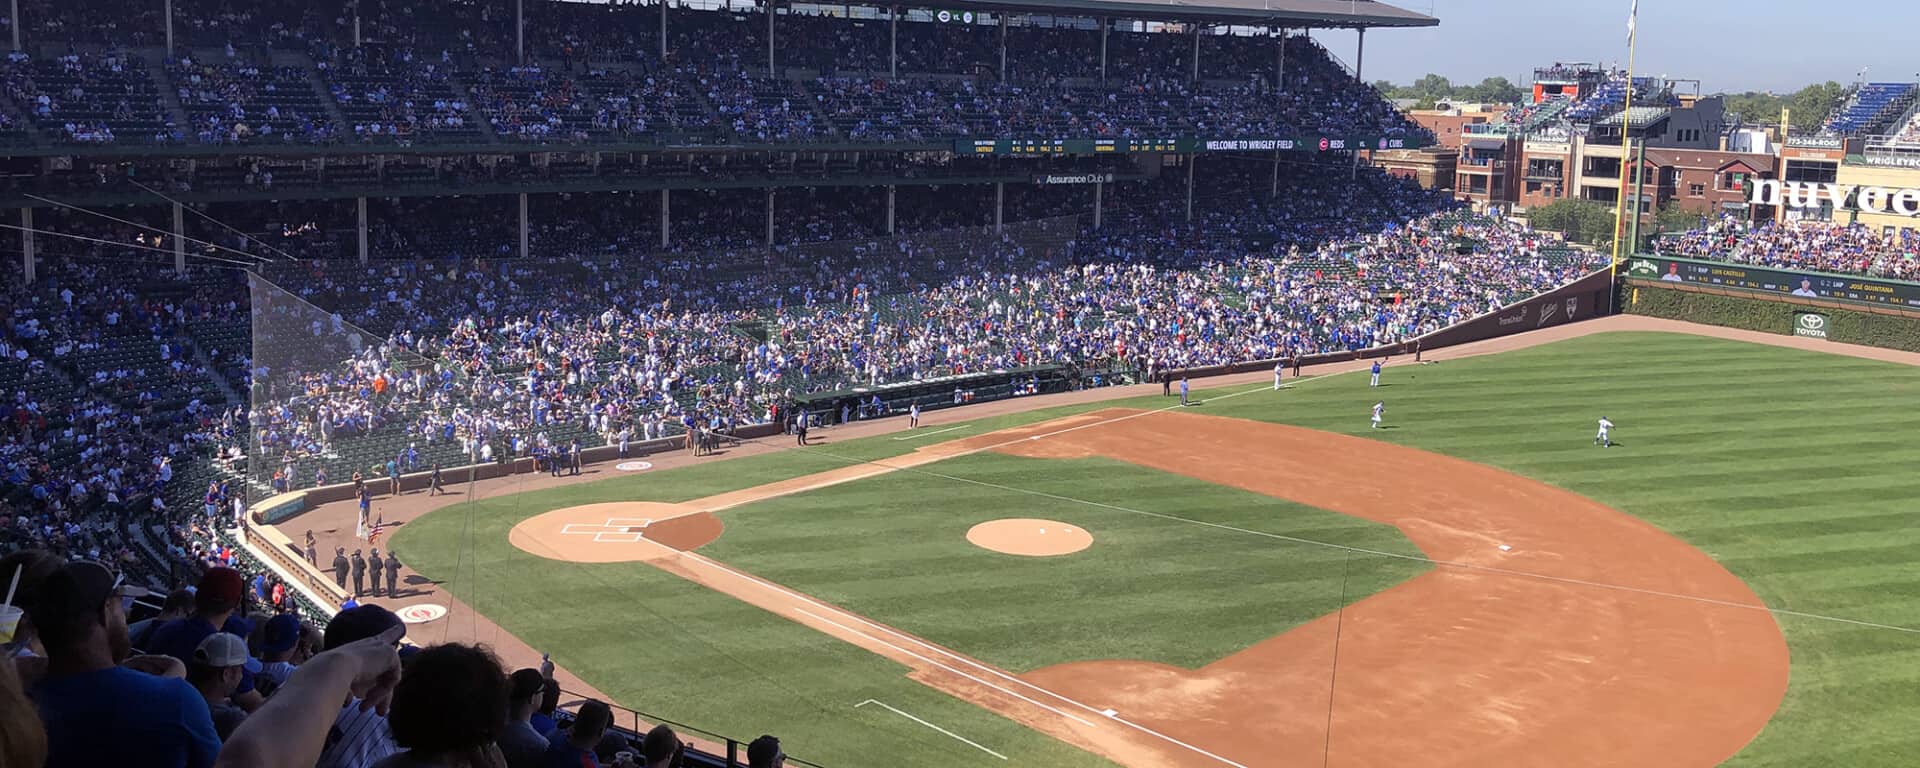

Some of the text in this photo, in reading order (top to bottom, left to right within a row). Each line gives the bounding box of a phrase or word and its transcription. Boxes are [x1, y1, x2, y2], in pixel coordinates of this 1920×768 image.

[1206, 140, 1294, 150] WELCOME TO WRIGLEY FIELD
[1330, 139, 1345, 149] REDS
[1389, 139, 1404, 148] CUBS
[1046, 174, 1104, 184] Assurance Club
[1863, 284, 1894, 294] QUINTANA
[1795, 327, 1827, 338] TOYOTA
